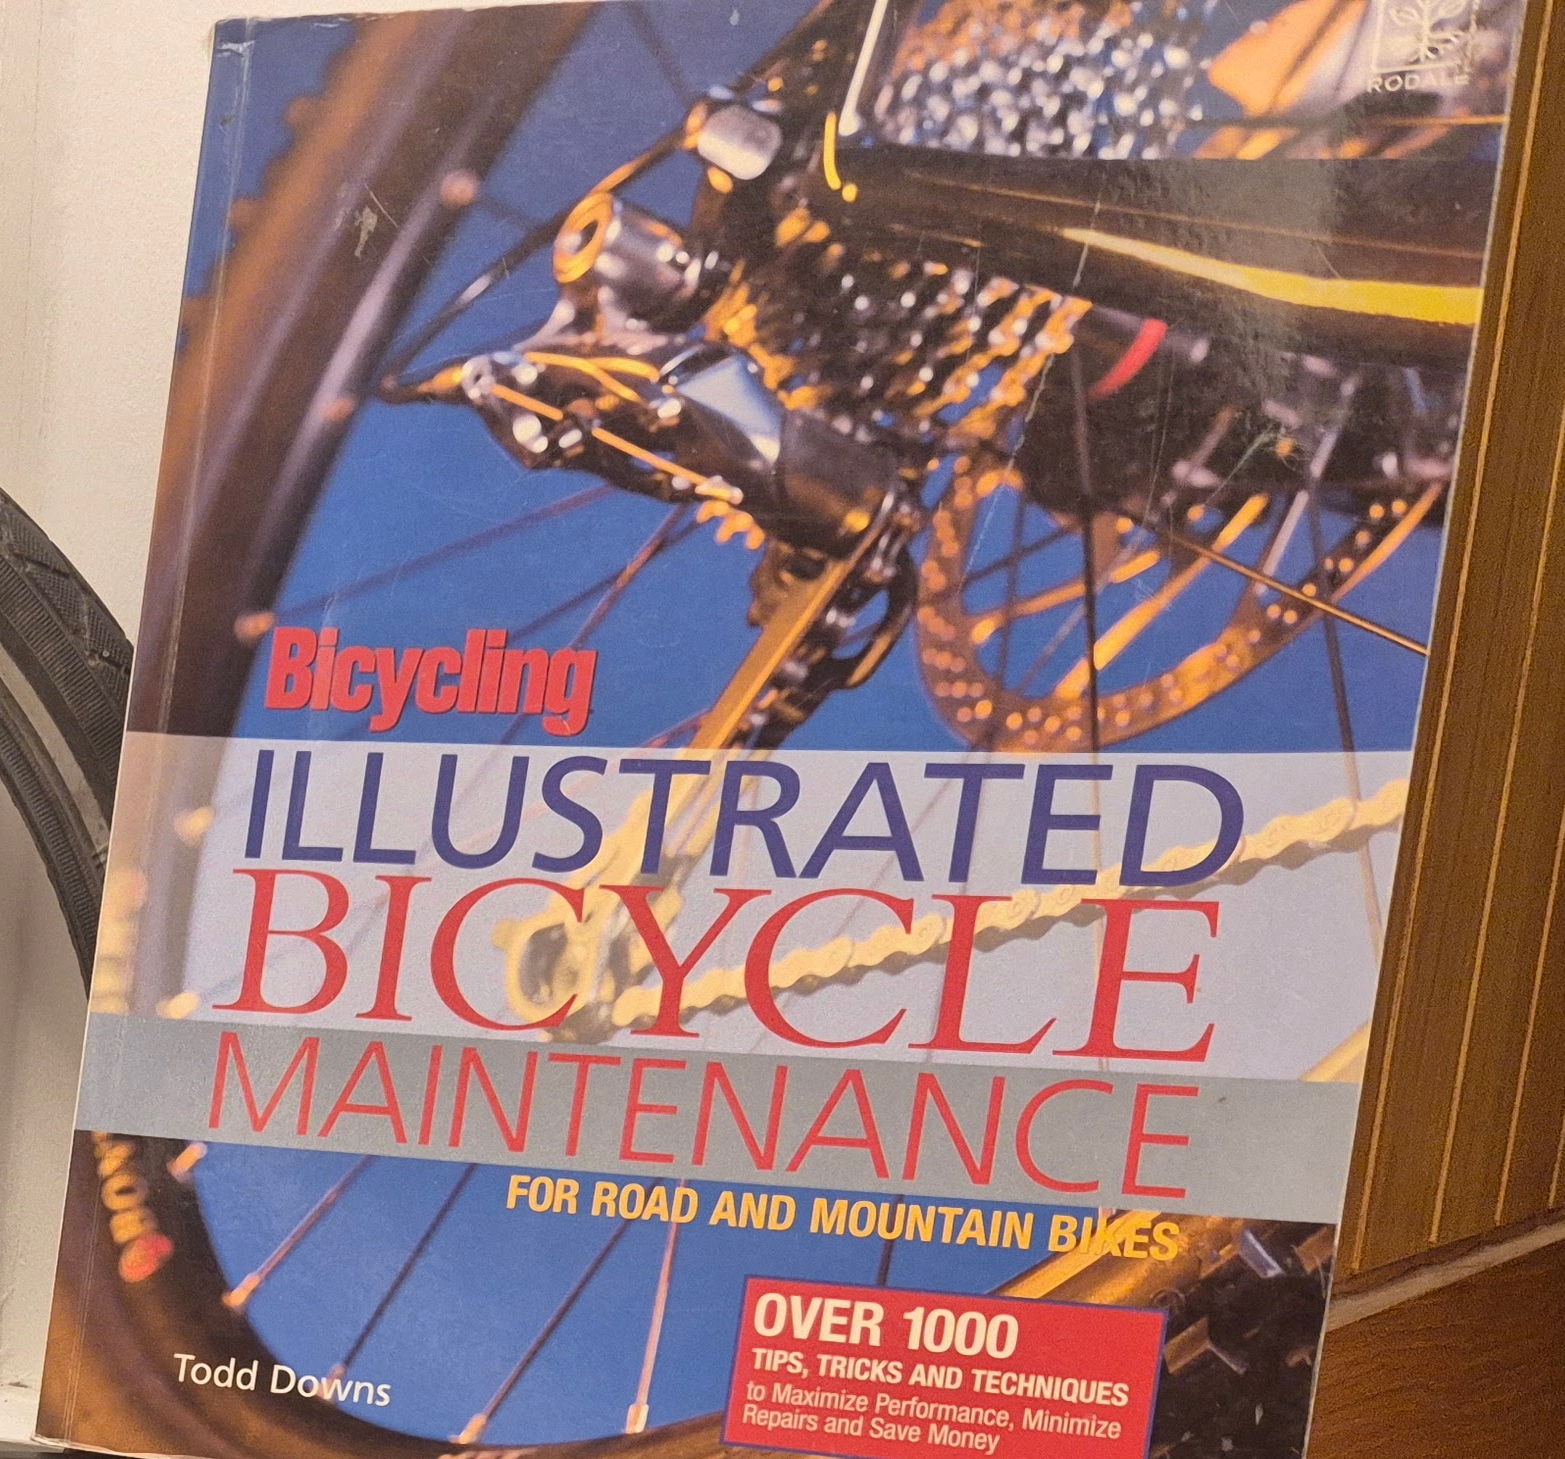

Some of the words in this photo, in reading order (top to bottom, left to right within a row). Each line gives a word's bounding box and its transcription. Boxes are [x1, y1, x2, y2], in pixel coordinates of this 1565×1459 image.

[264, 627, 597, 736] Bicycling
[243, 749, 1244, 887] ILLUSTRATED
[212, 868, 1220, 1062] BICYCLE
[208, 1031, 1199, 1199] MAINTENANCE
[506, 1174, 579, 1215] FOR
[592, 1180, 699, 1224] ROAD
[710, 1189, 796, 1231] AND
[809, 1197, 1033, 1250] MOUNTAIN
[1048, 1212, 1182, 1261] BIKES
[753, 1291, 883, 1346] OVER
[903, 1307, 1020, 1359] 1000
[173, 1353, 259, 1391] Todd
[270, 1364, 392, 1407] Downs
[745, 1380, 766, 1402] to
[771, 1381, 869, 1414] Maximize
[875, 1393, 1016, 1430] Performance,
[1022, 1408, 1122, 1440] Minimize
[751, 1346, 809, 1379] TIPS,
[817, 1352, 903, 1384] TRICKS
[908, 1361, 963, 1390] AND
[971, 1368, 1130, 1408] TECHNIQUES
[741, 1404, 819, 1432] Repairs
[824, 1412, 864, 1436] and
[869, 1417, 922, 1443] Save
[927, 1422, 1001, 1456] Money
